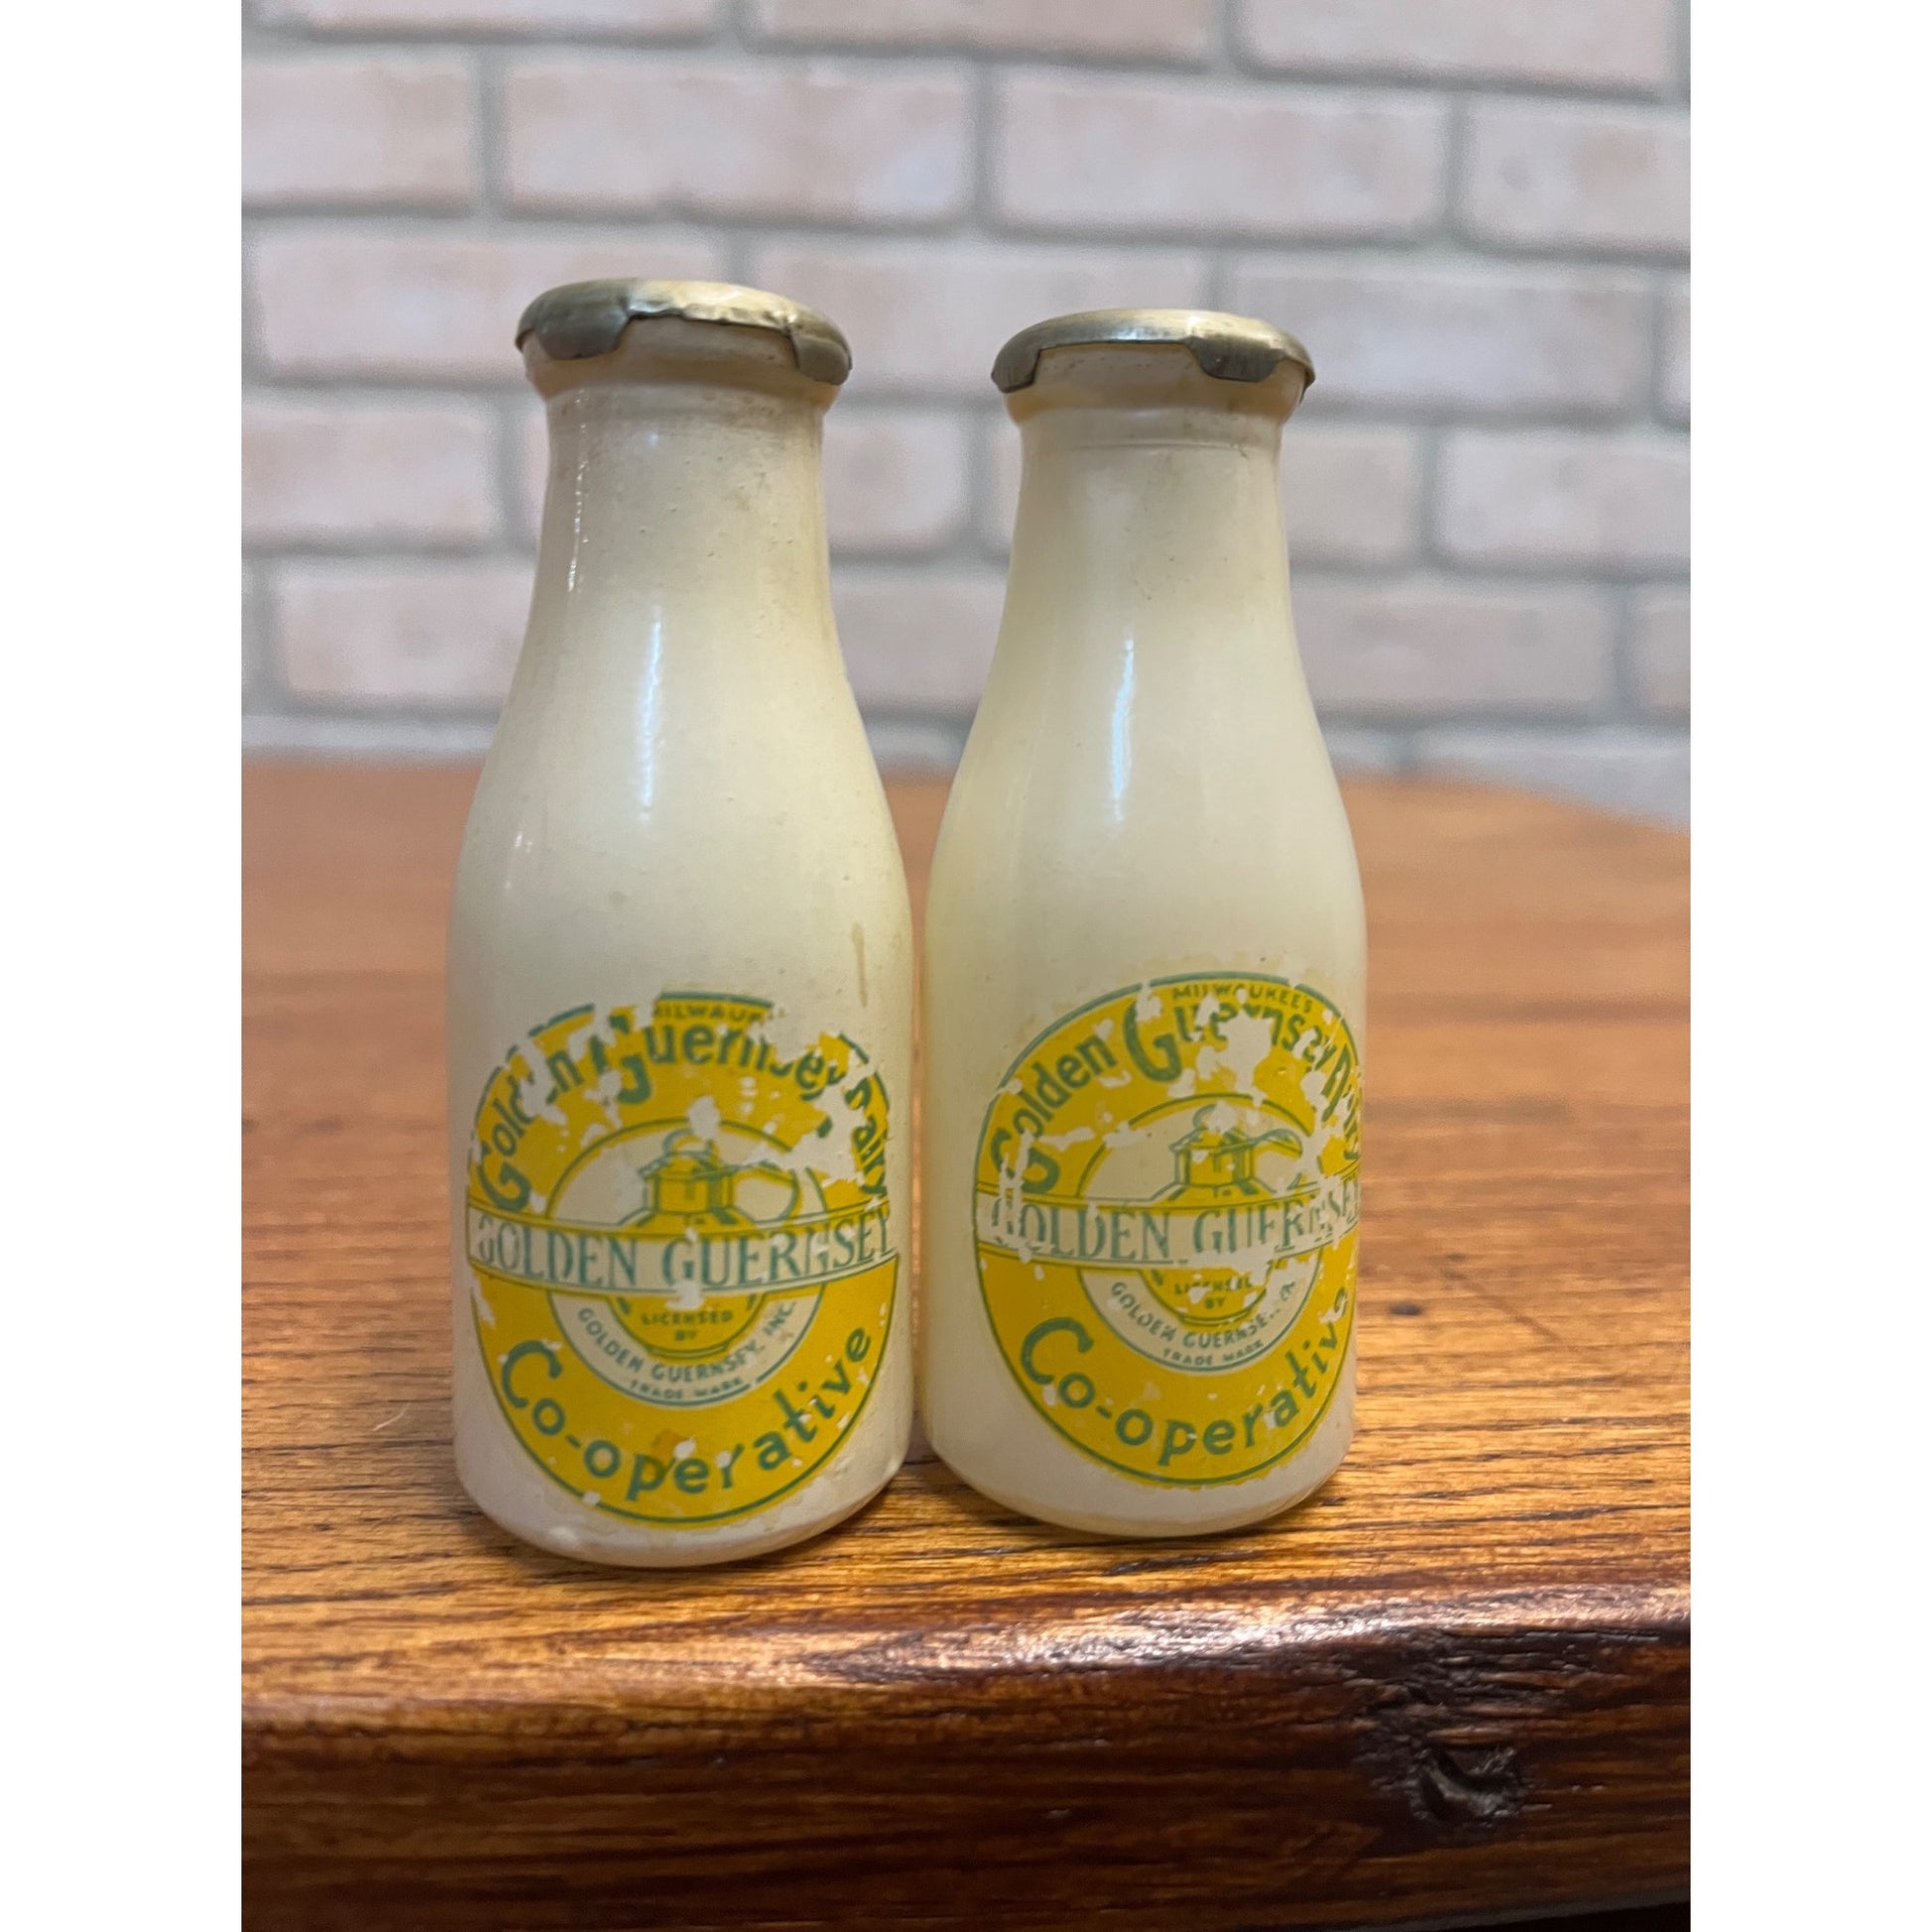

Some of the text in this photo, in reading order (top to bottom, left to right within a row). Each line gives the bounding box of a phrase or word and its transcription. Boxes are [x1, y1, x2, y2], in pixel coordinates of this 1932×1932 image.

[1173, 984, 1313, 1014] MILWUKEES
[477, 1050, 584, 1213] Goldn
[478, 1204, 890, 1290] GOLDEN GUERNSEY
[641, 1310, 734, 1324] LICENSED
[1111, 1282, 1176, 1341] GOLDEN
[1204, 1298, 1225, 1310] BY
[578, 1308, 644, 1372] GOLDEN
[674, 1329, 698, 1341] BY
[1163, 1339, 1265, 1365] TRADE MARK
[1020, 1286, 1348, 1466] Co-operative
[500, 1326, 872, 1502] Co-operative
